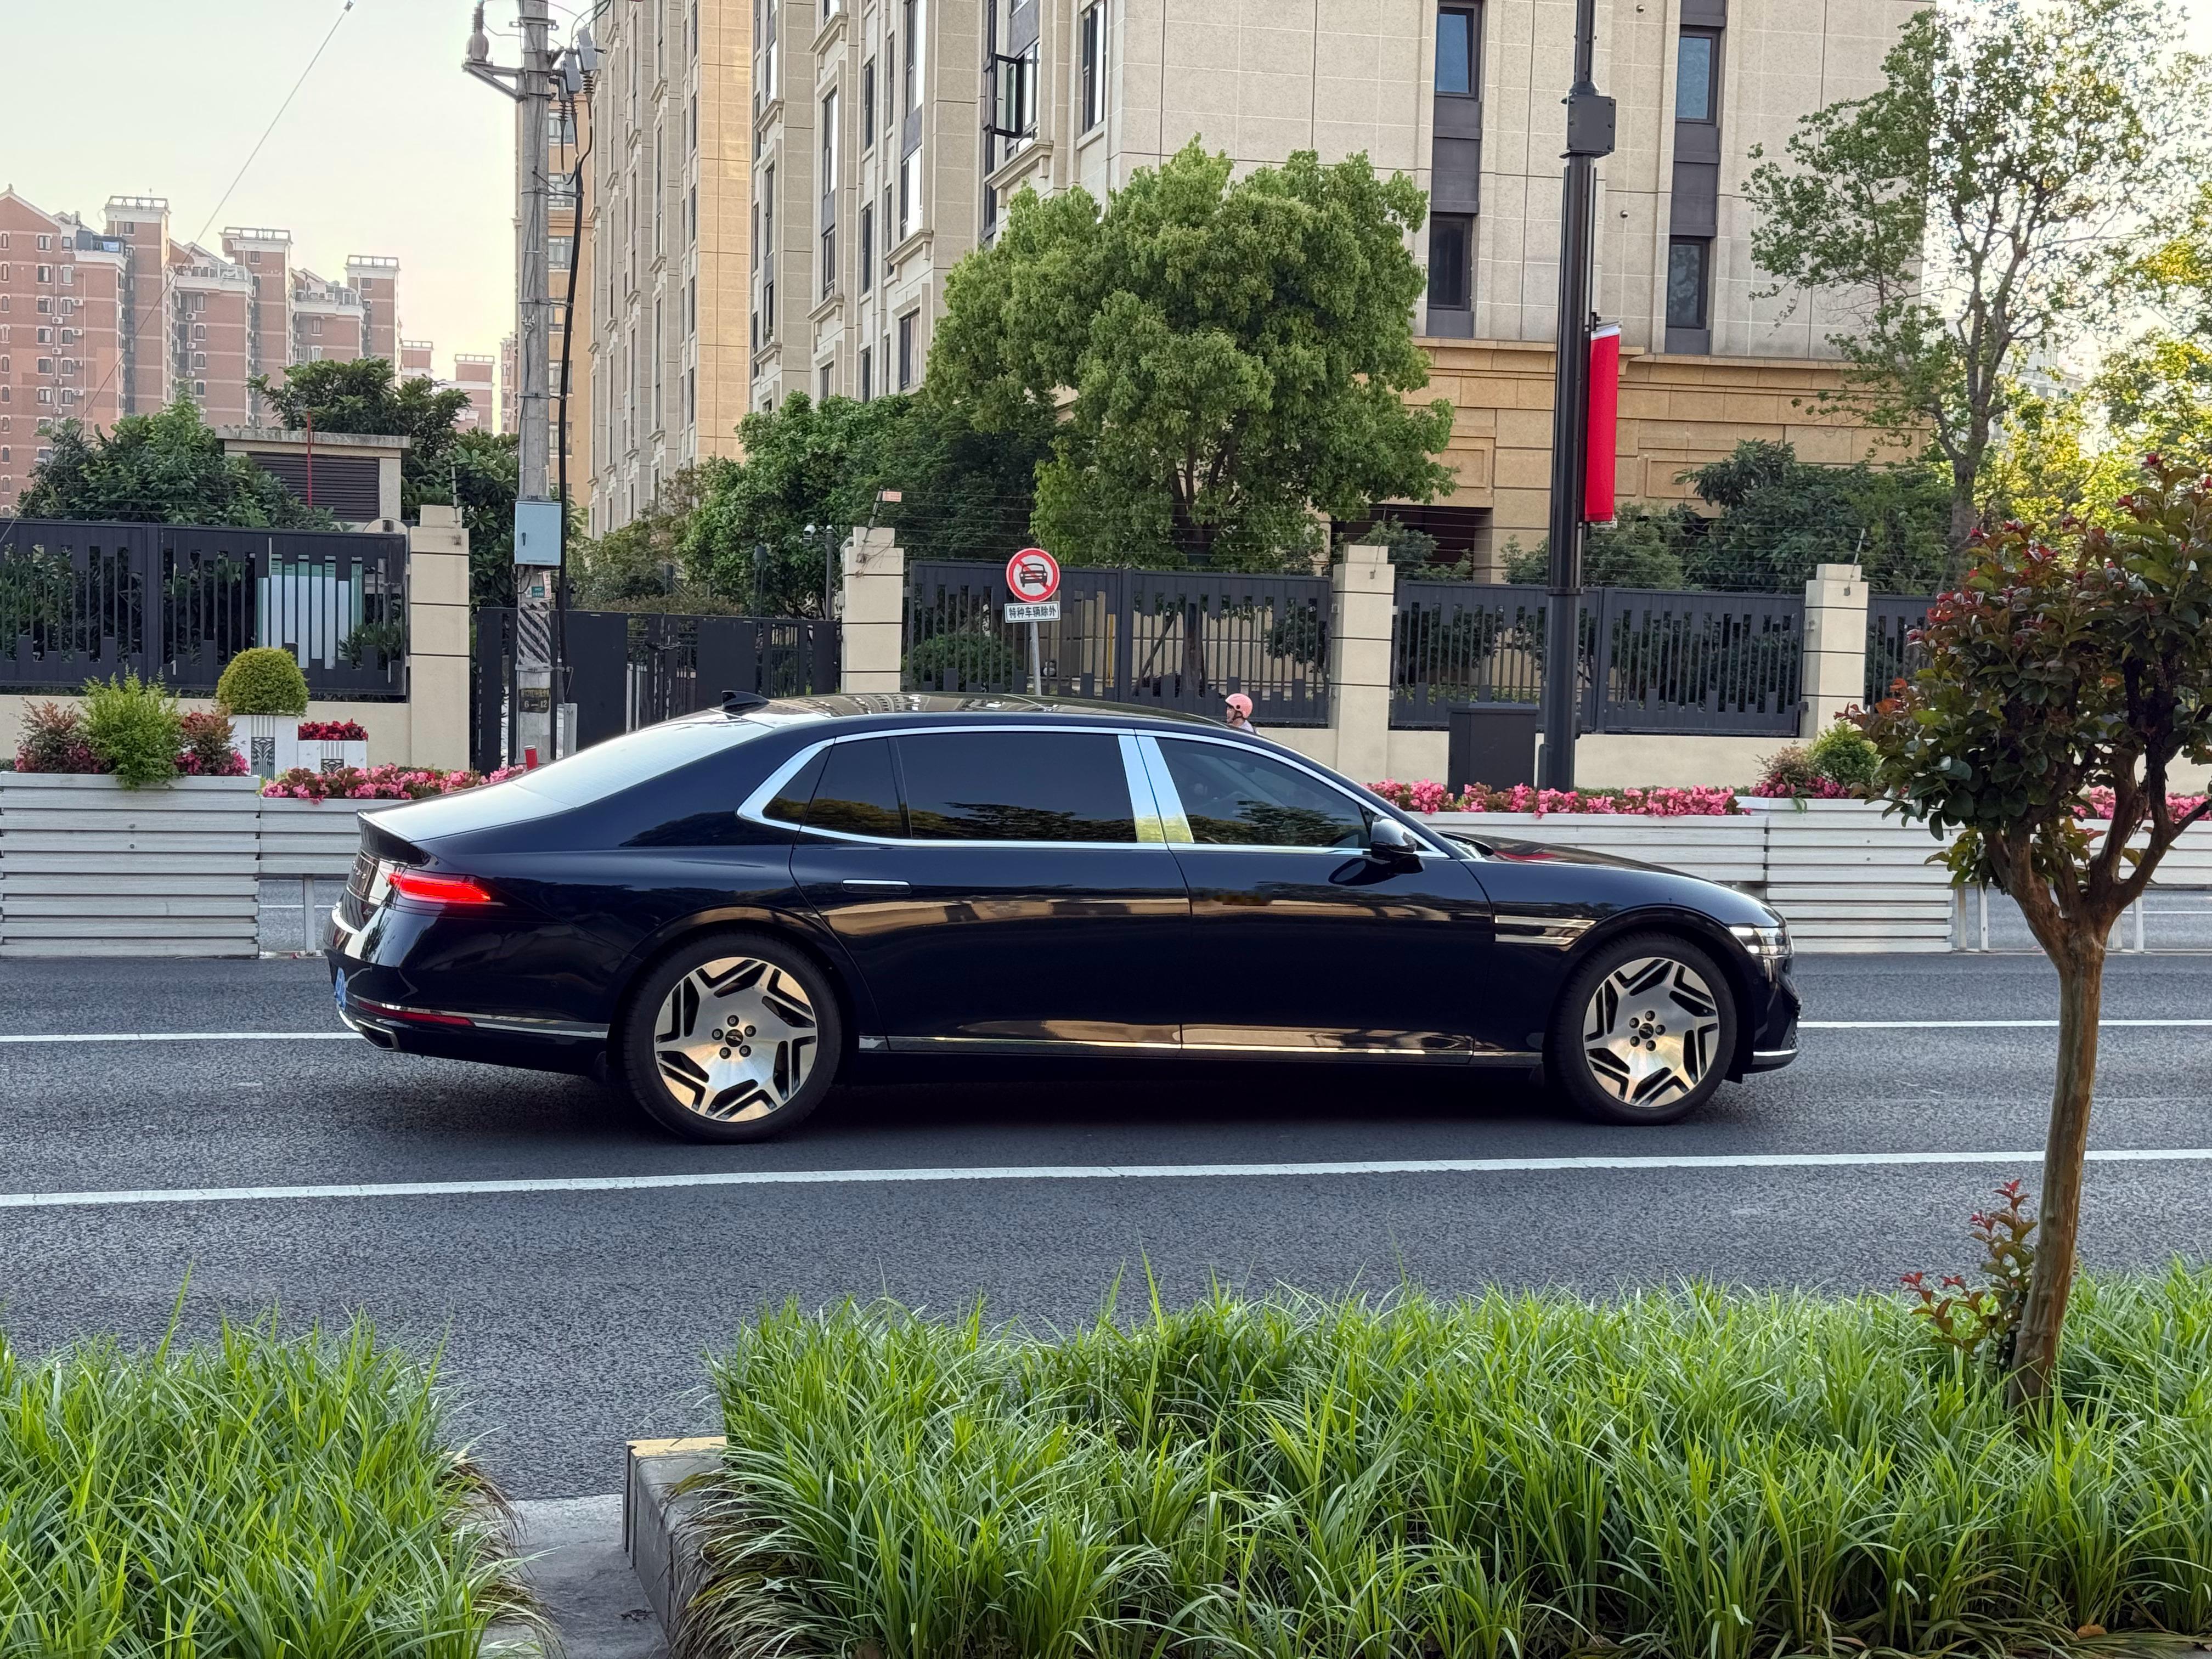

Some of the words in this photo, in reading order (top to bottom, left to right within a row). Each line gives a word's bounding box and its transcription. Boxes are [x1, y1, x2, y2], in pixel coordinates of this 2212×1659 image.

[1009, 605, 1056, 618] 特种车辆除外
